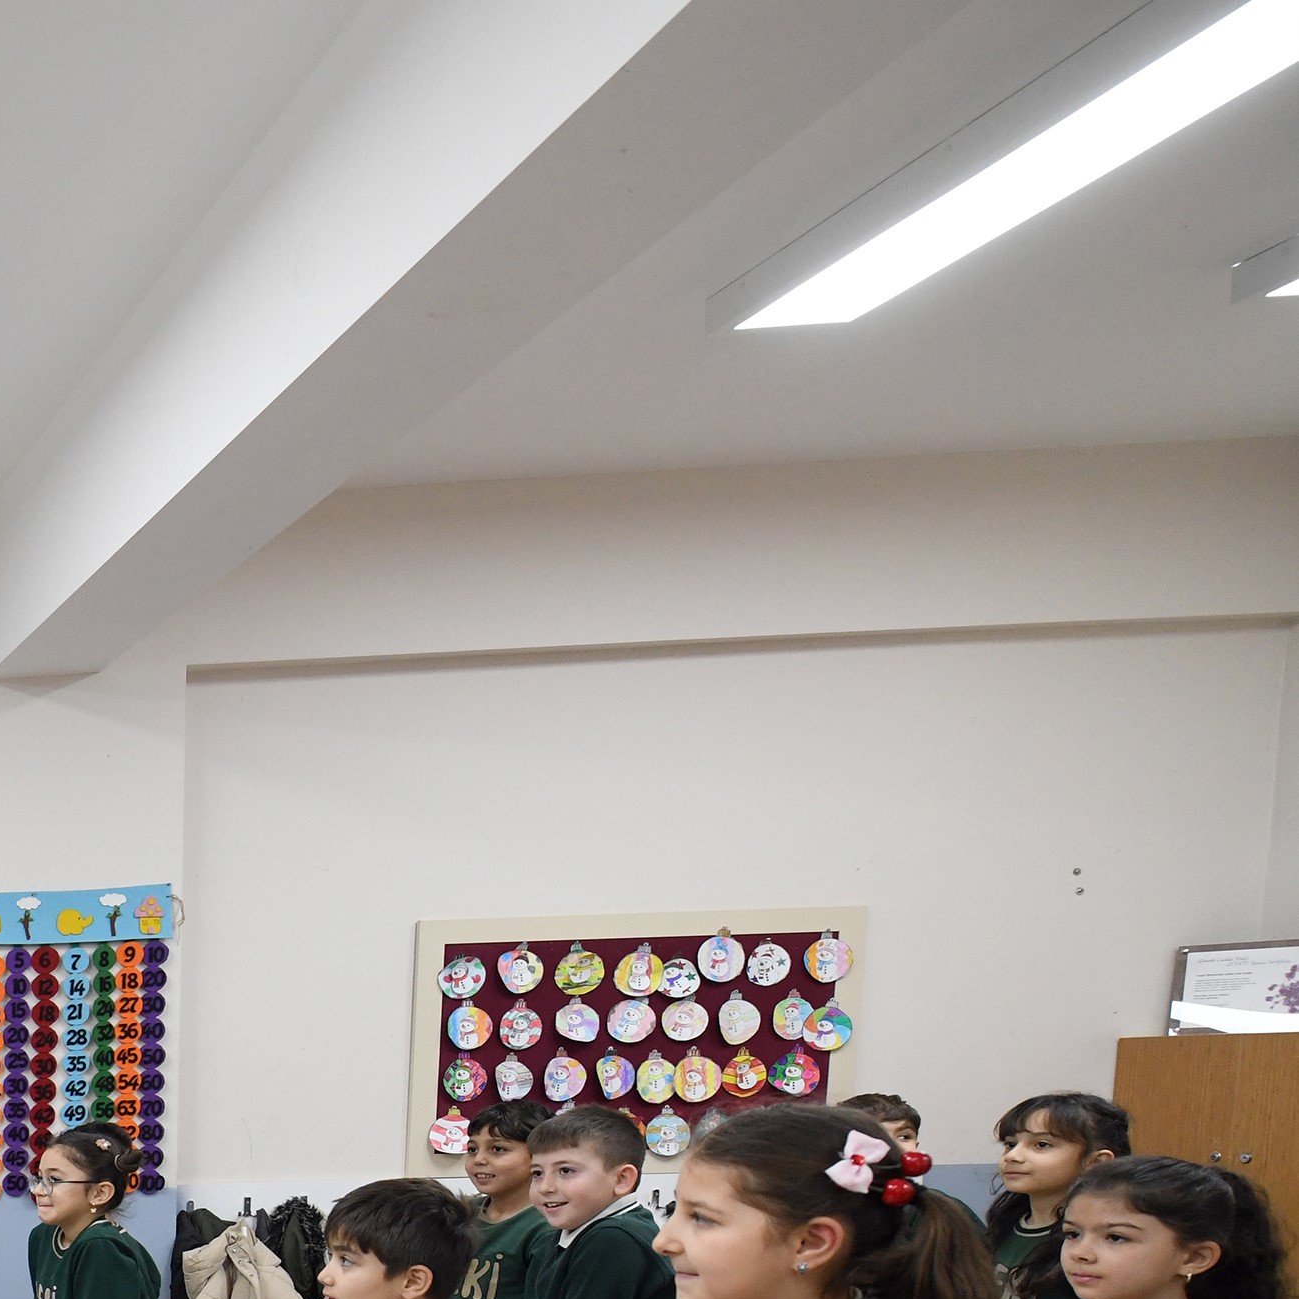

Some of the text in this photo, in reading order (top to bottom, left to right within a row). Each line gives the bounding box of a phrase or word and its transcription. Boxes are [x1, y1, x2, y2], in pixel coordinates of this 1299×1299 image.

[15, 952, 24, 968] 5
[40, 952, 51, 968] 6
[71, 955, 81, 970] 7
[99, 951, 109, 967] 8
[124, 947, 135, 962] 9
[148, 947, 164, 963] 10
[13, 978, 26, 994] 10
[39, 979, 53, 995] 12
[69, 979, 85, 996] 14
[99, 976, 112, 992] 16
[121, 973, 138, 989] 18
[144, 971, 166, 987] 20
[12, 1003, 26, 1018] 15
[40, 1006, 55, 1021] 18
[67, 1003, 83, 1020] 21
[97, 1000, 114, 1016] 24
[120, 997, 139, 1013] 27
[144, 996, 161, 1012] 30
[8, 1027, 28, 1043] 20
[37, 1032, 55, 1047] 24
[67, 1029, 87, 1045] 28
[98, 1024, 114, 1041] 32
[118, 1023, 138, 1039] 36
[143, 1023, 163, 1038] 40
[9, 1053, 28, 1069] 25
[36, 1059, 55, 1075] 30
[67, 1056, 86, 1072] 35
[97, 1050, 114, 1066] 40
[117, 1048, 138, 1064] 45
[143, 1049, 163, 1064] 50
[8, 1079, 26, 1094] 30
[34, 1085, 52, 1101] 36
[65, 1080, 86, 1096] 42
[96, 1076, 114, 1092] 48
[119, 1074, 139, 1090] 54
[142, 1075, 162, 1090] 60
[8, 1103, 26, 1118] 35
[34, 1107, 54, 1123] 42
[64, 1105, 85, 1121] 49
[96, 1102, 114, 1118] 56
[118, 1100, 136, 1116] 63
[142, 1100, 162, 1116] 70
[9, 1127, 29, 1142] 40
[142, 1125, 162, 1141] 80
[6, 1150, 26, 1166] 45
[7, 1176, 27, 1191] 50
[129, 1174, 138, 1188] 0
